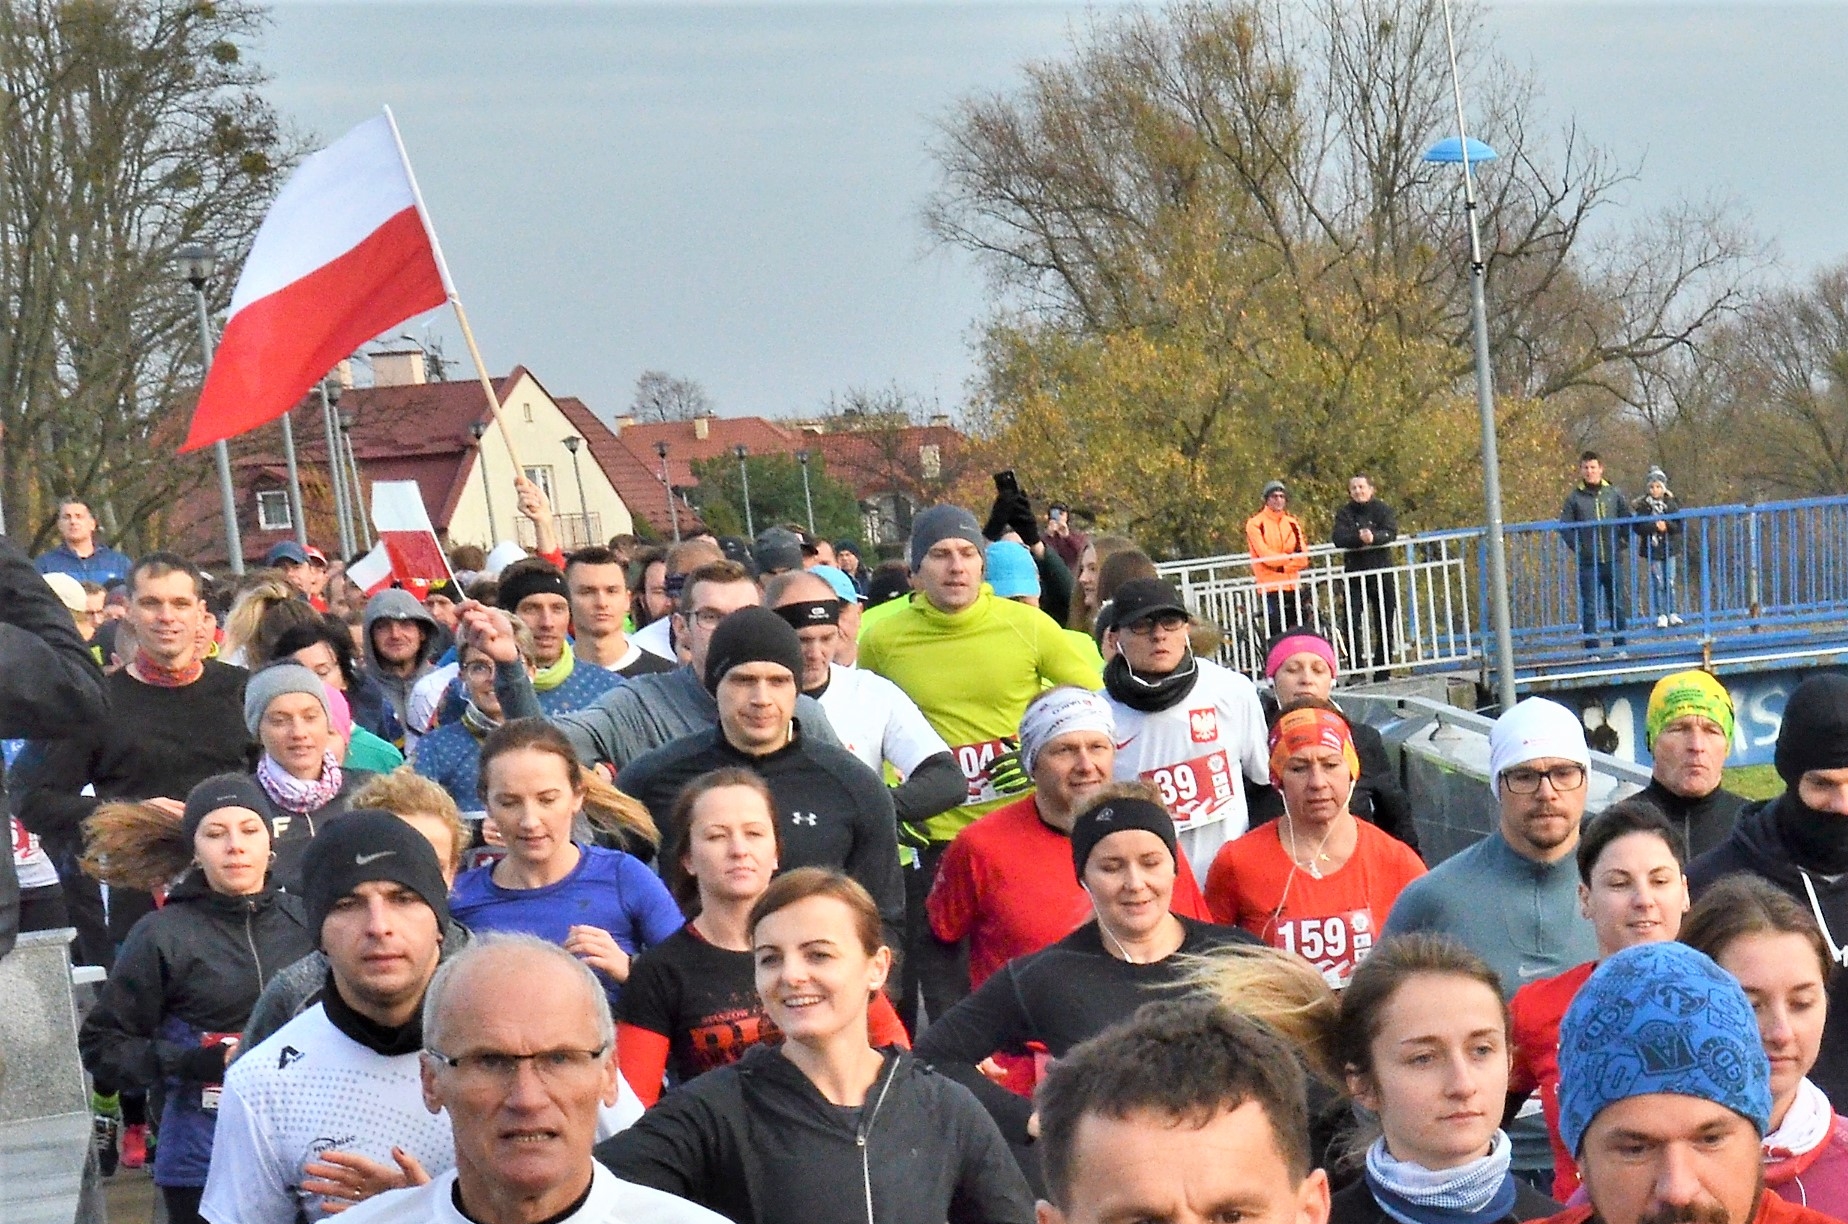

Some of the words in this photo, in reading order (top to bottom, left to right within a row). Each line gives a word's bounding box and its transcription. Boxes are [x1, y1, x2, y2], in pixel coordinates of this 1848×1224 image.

[959, 744, 995, 778] 04
[1154, 765, 1197, 805] 39
[1277, 917, 1347, 959] 159
